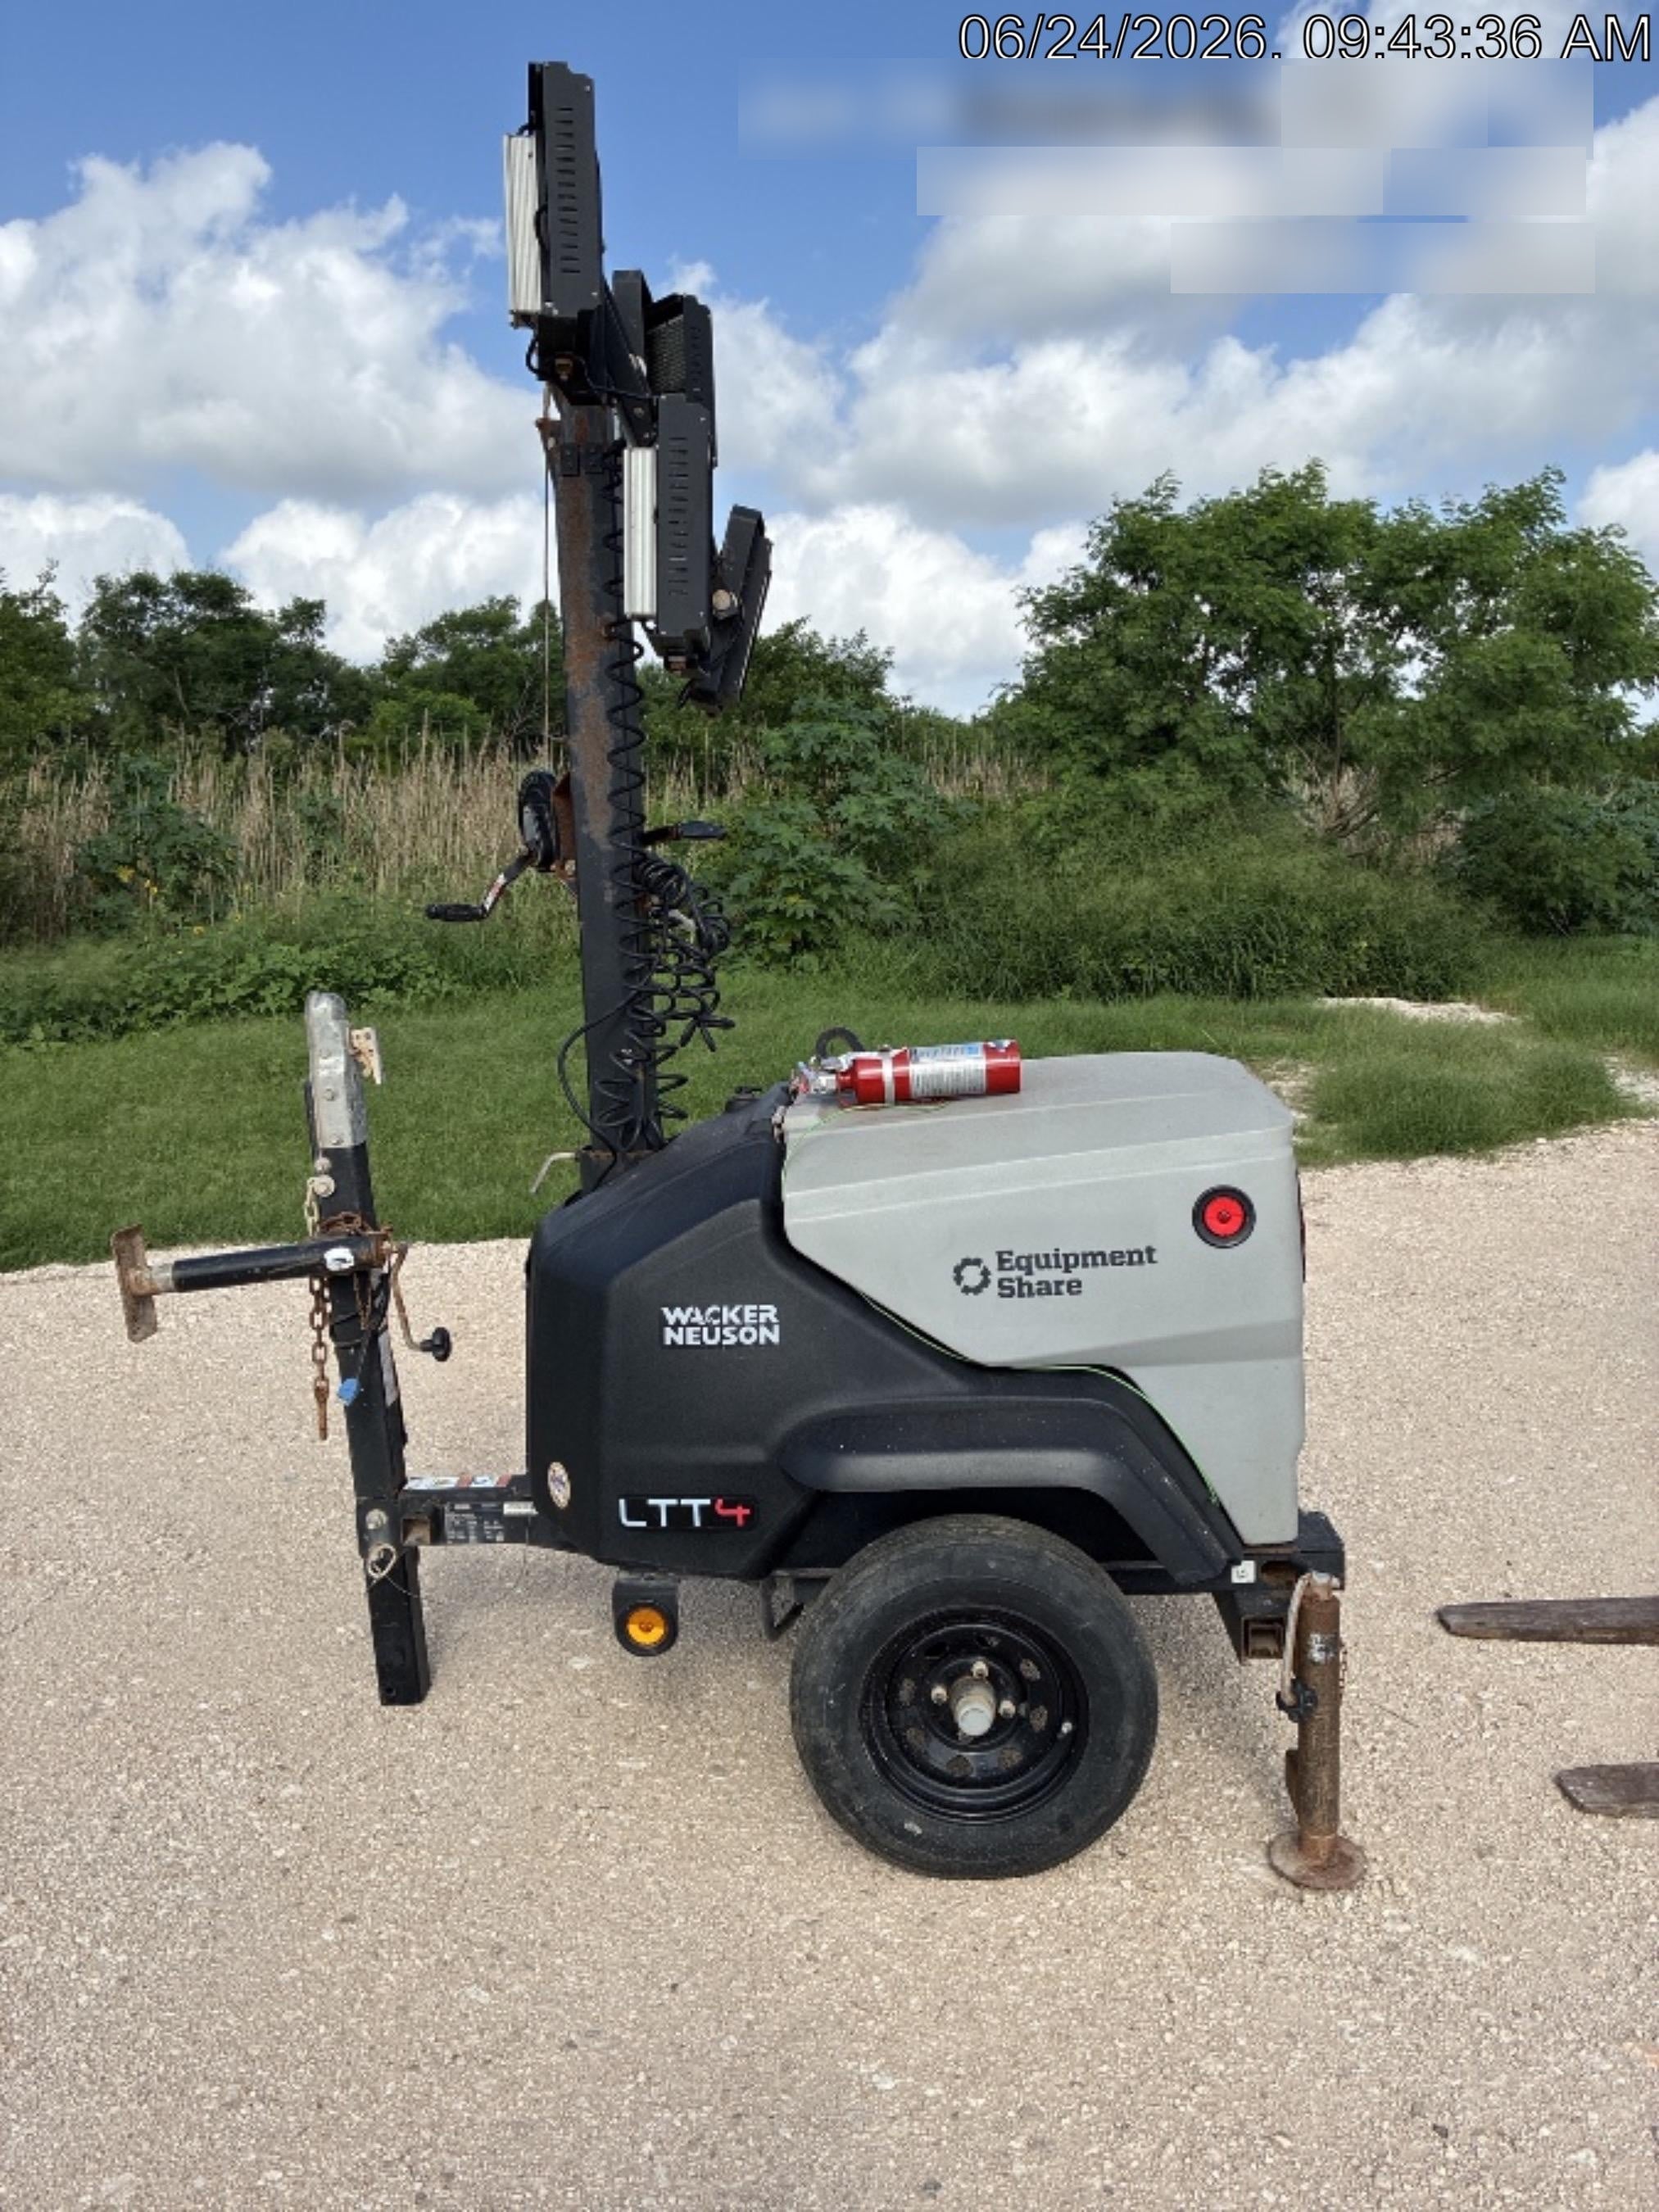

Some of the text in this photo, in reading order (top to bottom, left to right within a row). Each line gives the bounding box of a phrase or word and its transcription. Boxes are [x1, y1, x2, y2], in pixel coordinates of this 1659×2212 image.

[995, 1245, 1158, 1274] Equipment
[997, 1277, 1083, 1299] Share
[660, 1304, 779, 1325] WACKER
[663, 1324, 780, 1345] NEUSON
[619, 1498, 750, 1527] LTT4
